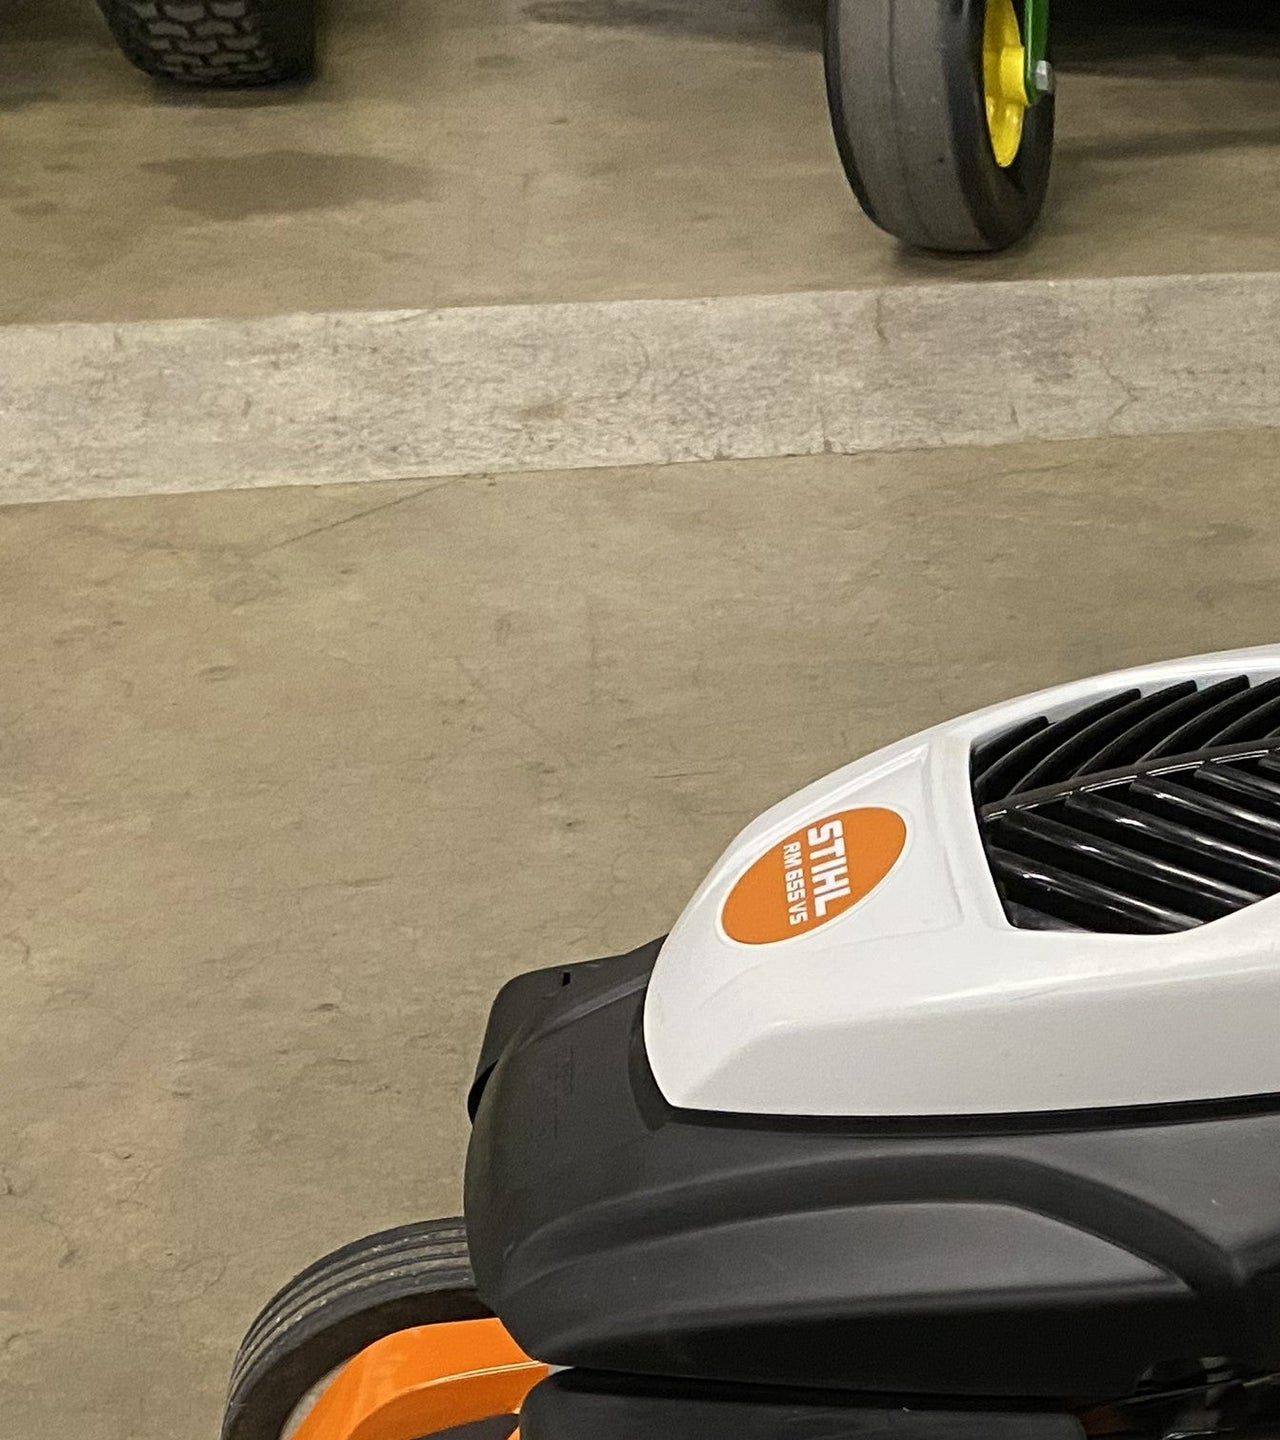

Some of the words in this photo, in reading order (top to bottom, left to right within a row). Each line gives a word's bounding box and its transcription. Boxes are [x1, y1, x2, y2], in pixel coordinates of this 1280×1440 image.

[783, 841, 802, 869] RM
[807, 820, 851, 917] STIHL
[785, 869, 806, 903] 655
